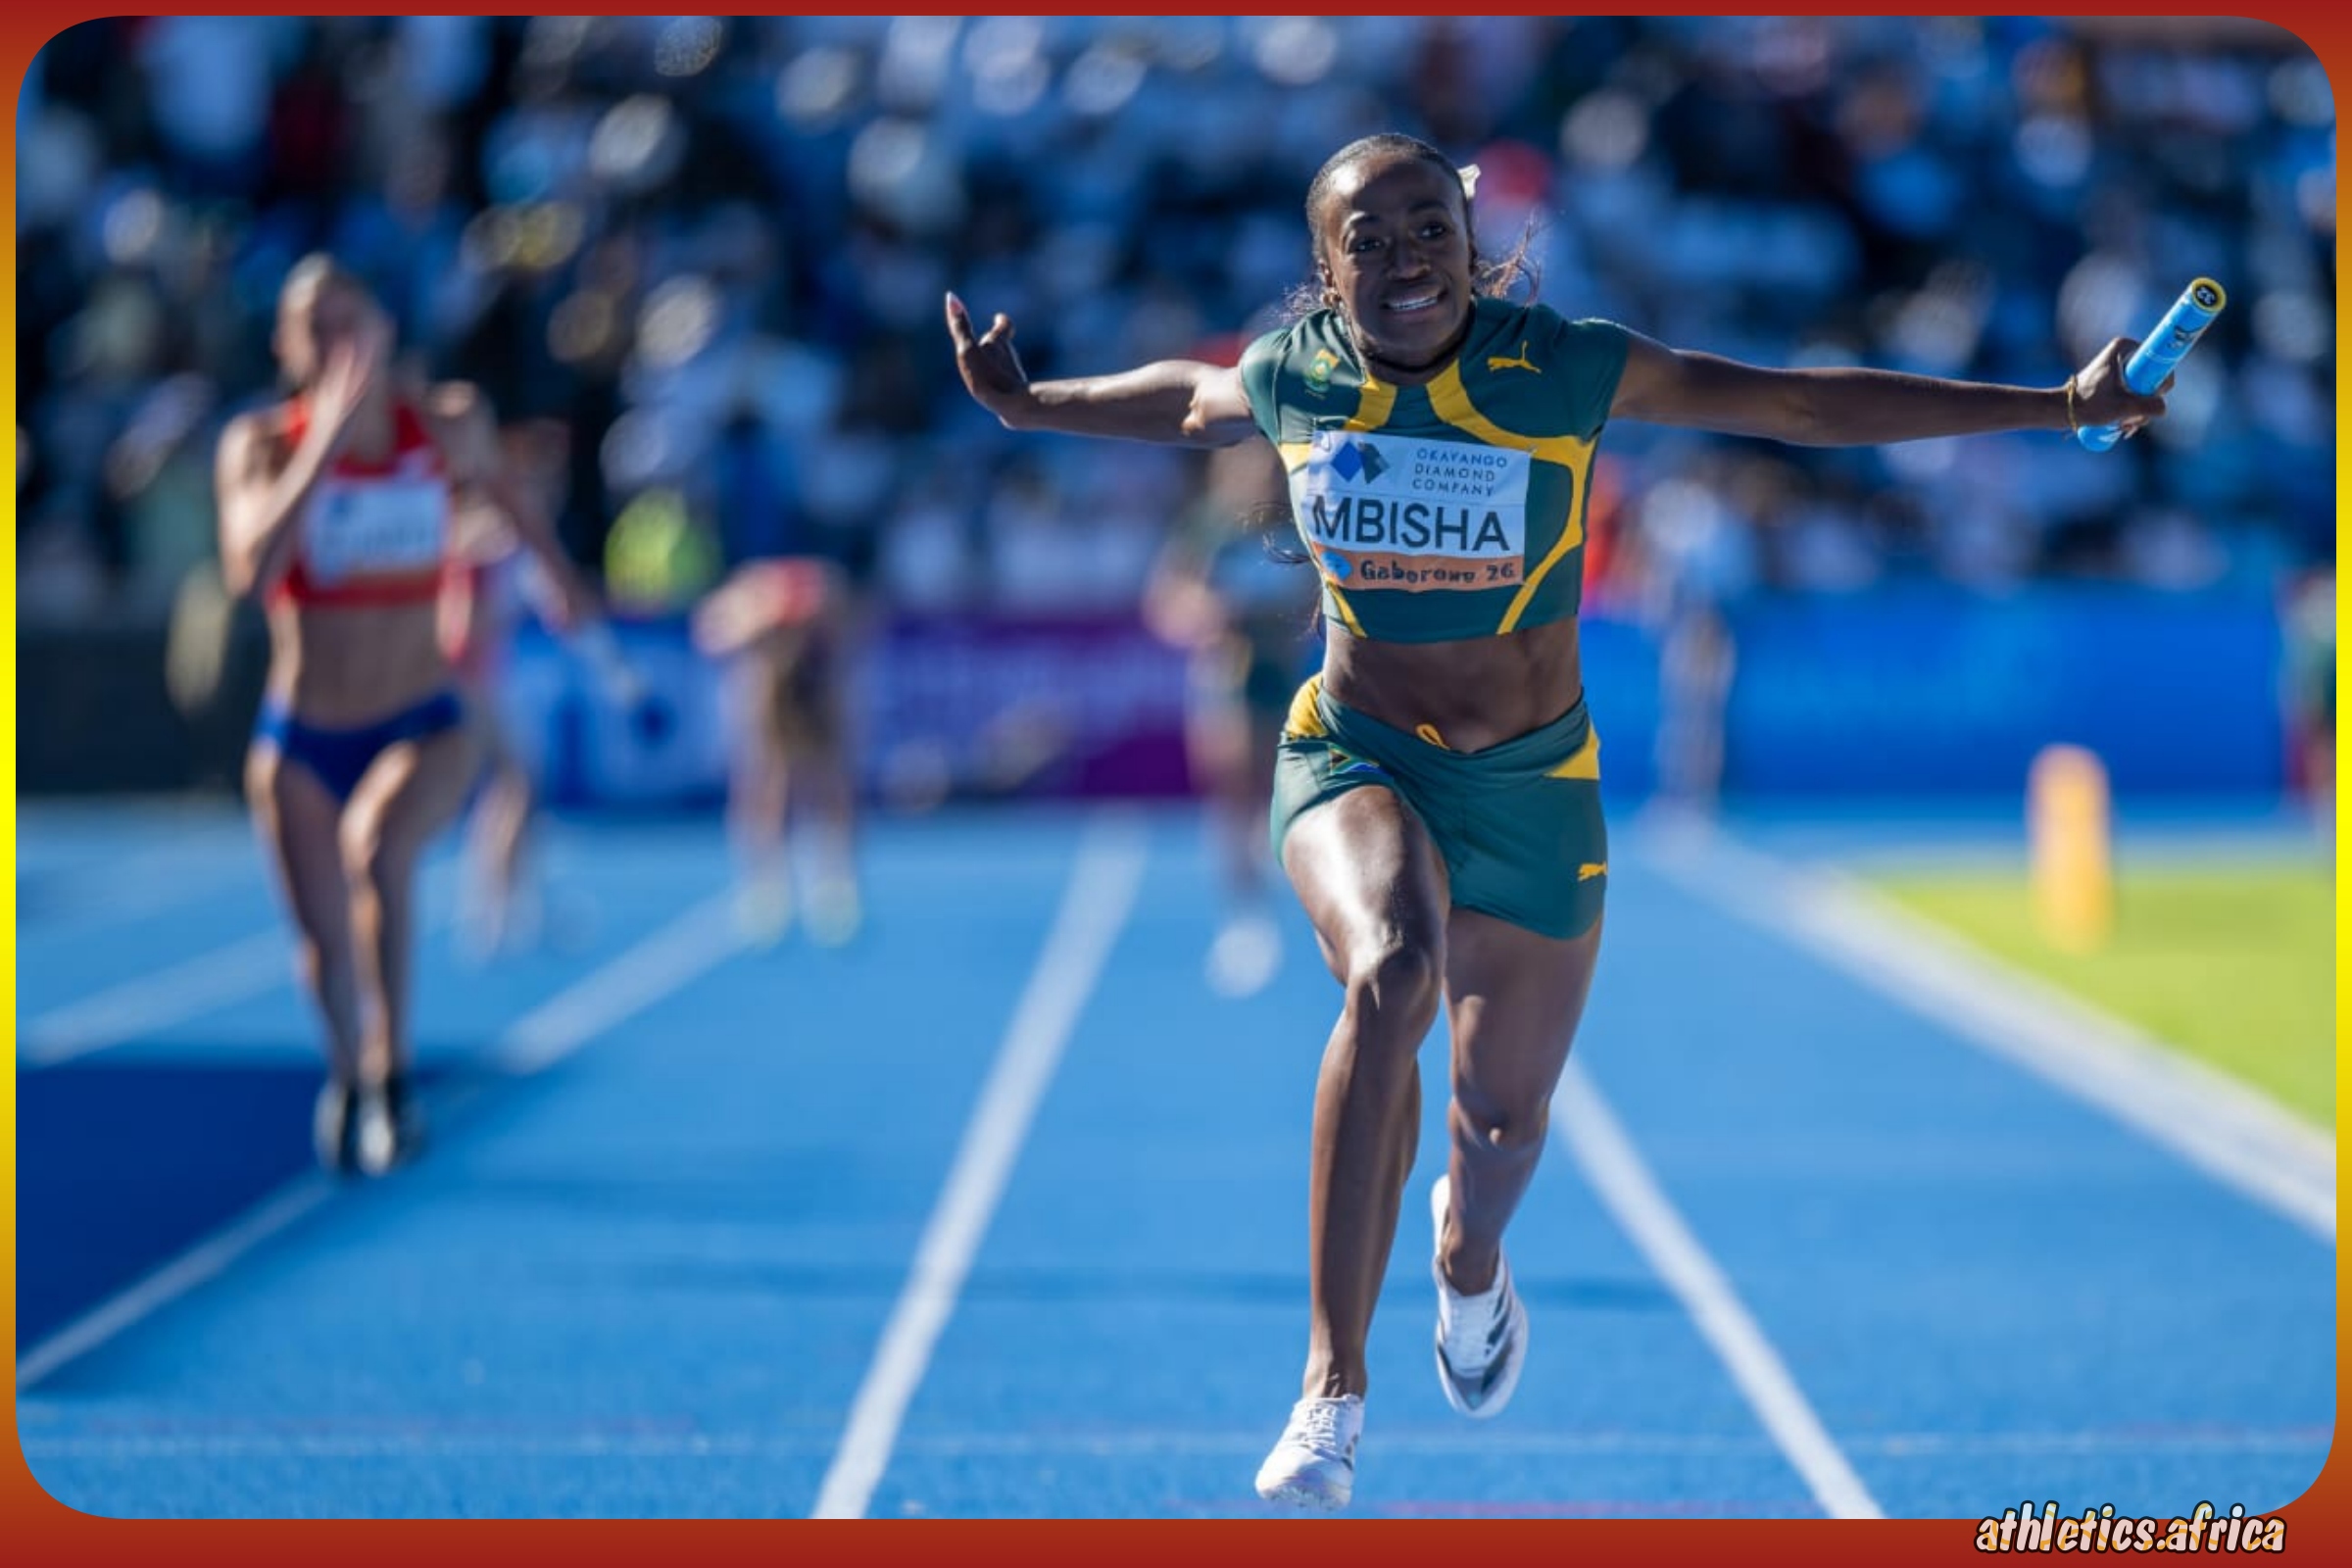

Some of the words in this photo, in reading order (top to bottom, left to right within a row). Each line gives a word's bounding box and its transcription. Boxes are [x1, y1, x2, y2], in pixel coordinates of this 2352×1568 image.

[1414, 463, 1495, 482] DIAMOND
[1412, 478, 1494, 497] COMPANY
[1311, 495, 1510, 552] MBISHA
[1486, 563, 1514, 581] 26
